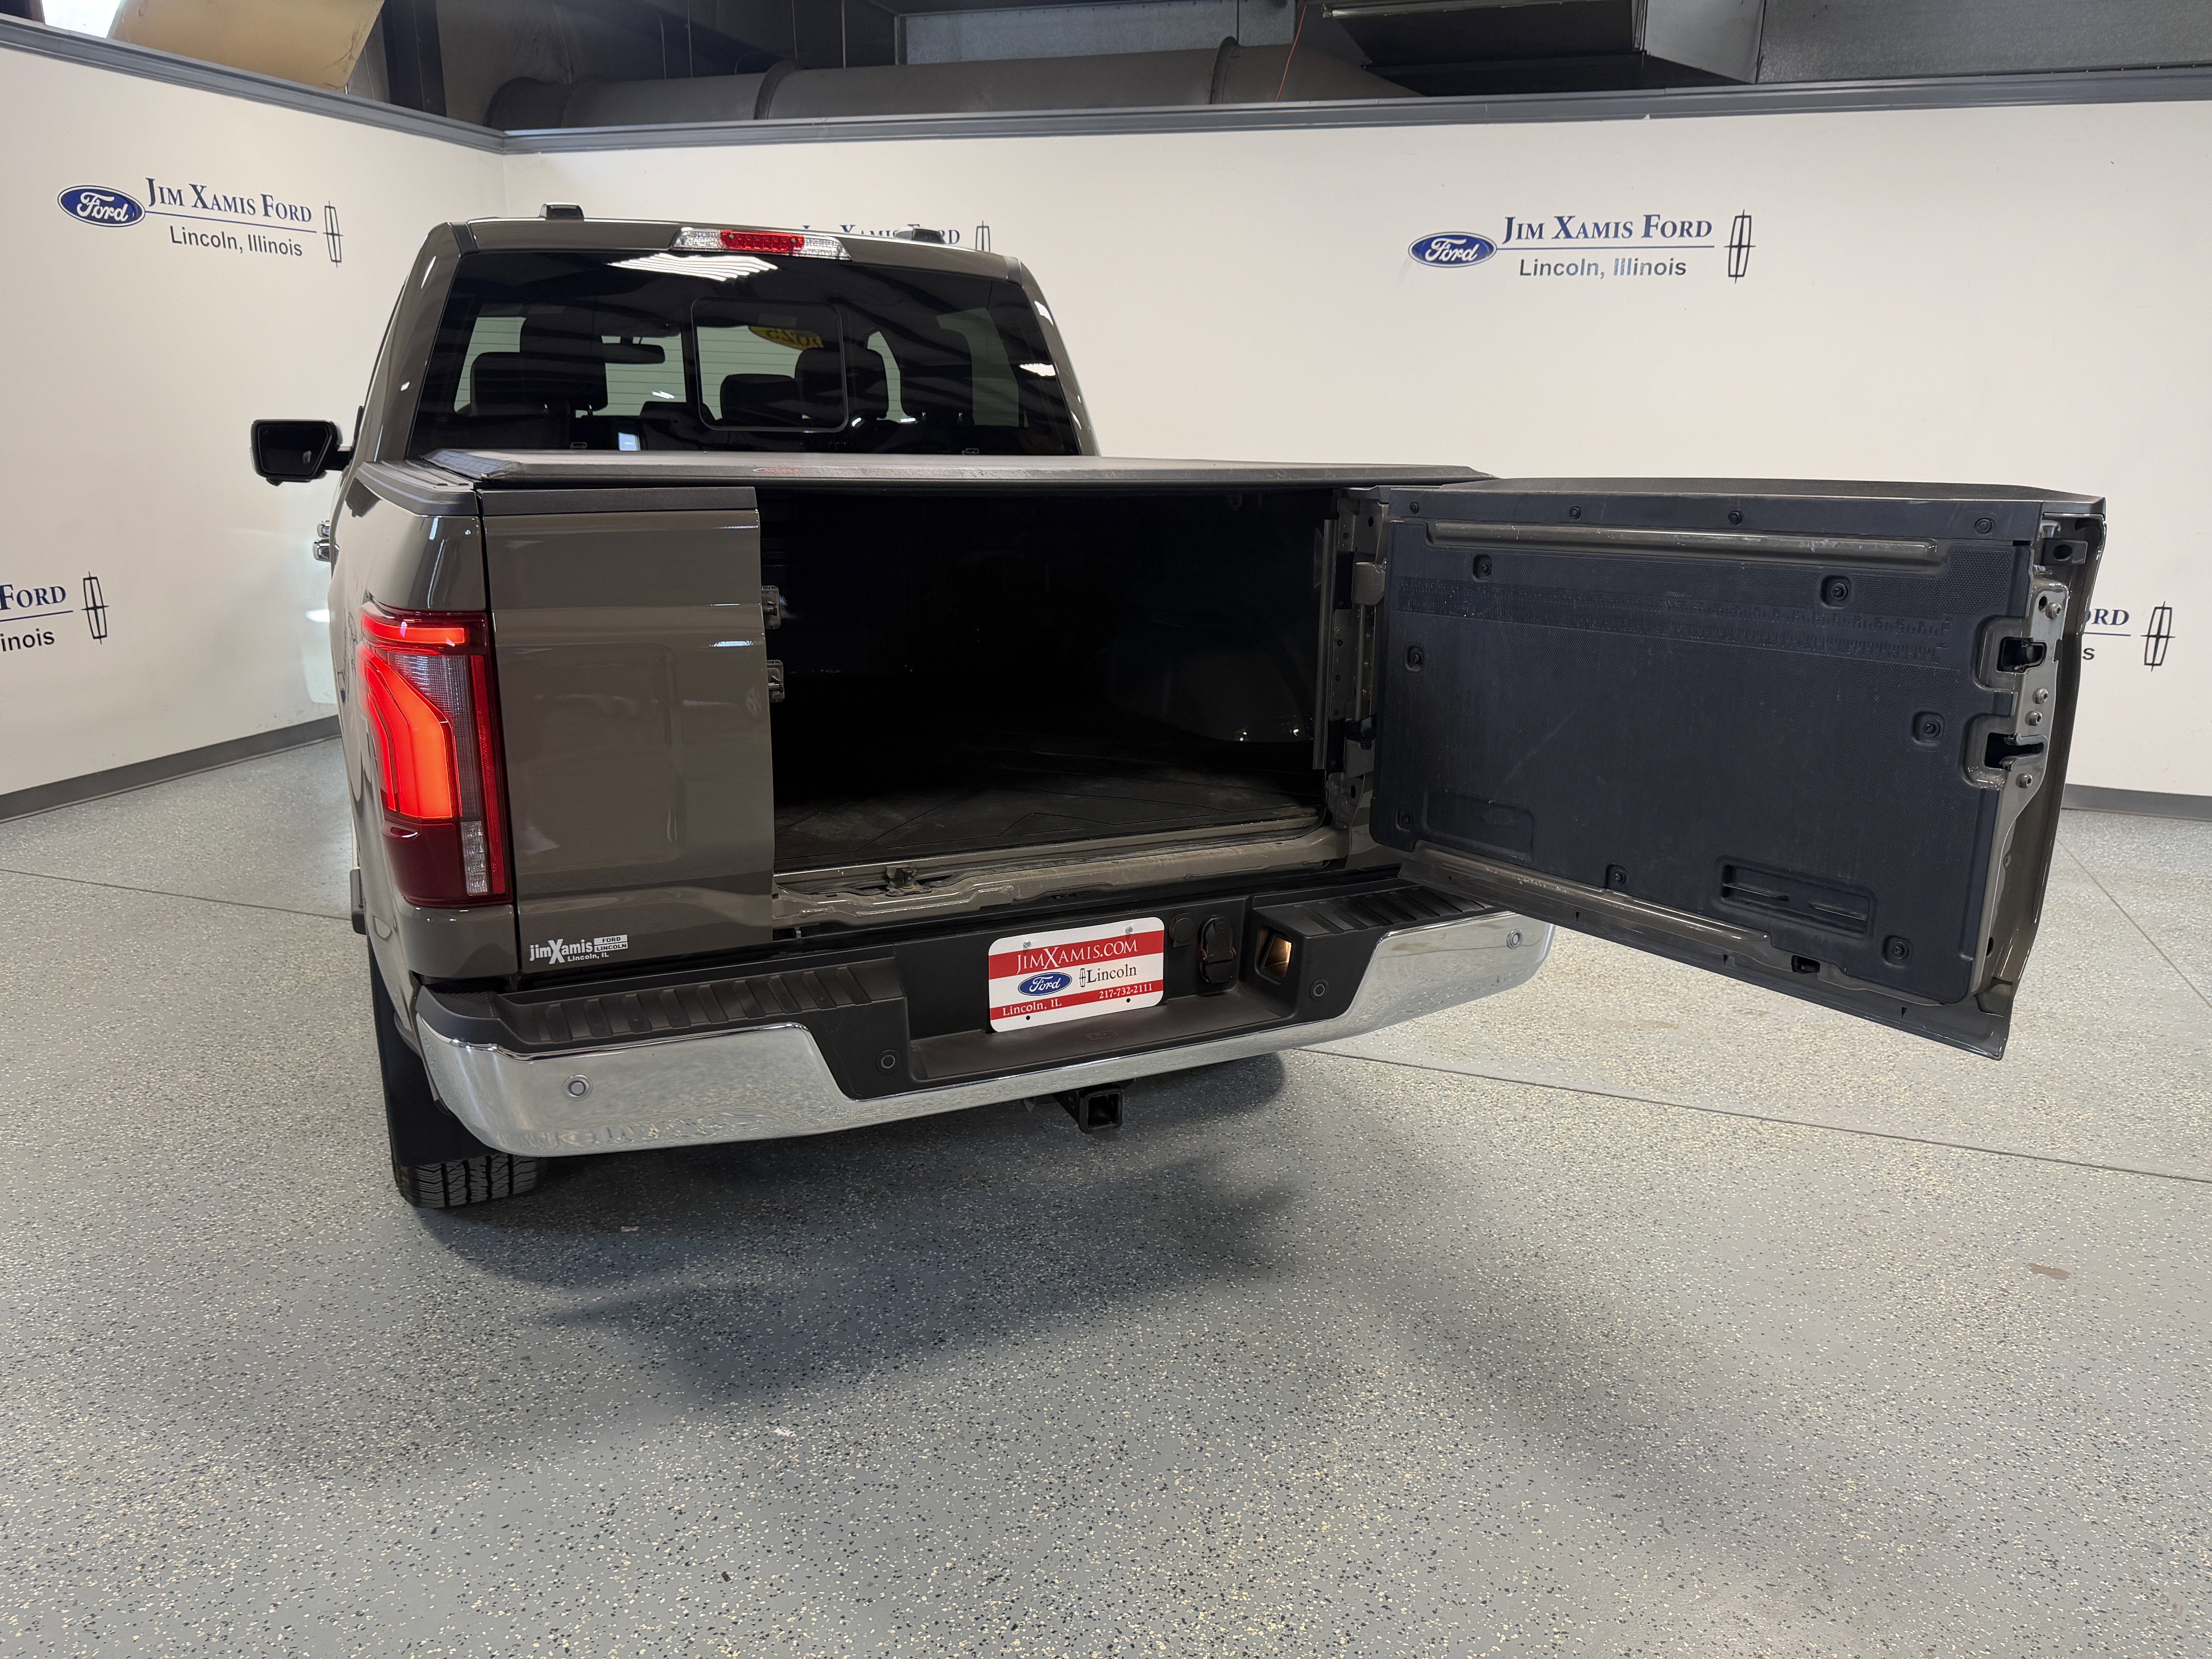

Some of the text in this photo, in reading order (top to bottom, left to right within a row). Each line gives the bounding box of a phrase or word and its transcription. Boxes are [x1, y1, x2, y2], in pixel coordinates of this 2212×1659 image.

[77, 192, 129, 222] Ford
[145, 177, 312, 222] JIM XAMIS FORD
[1502, 214, 1712, 244] JIM XAMIS FORD
[170, 225, 303, 256] Lincoln, Illinois
[1425, 238, 1478, 262] Ford
[1519, 258, 1686, 279] Lincoln, Illinois
[2088, 608, 2129, 625] RD
[530, 939, 593, 964] jimXamis
[568, 953, 599, 962] Lincoln,
[1017, 939, 1138, 975] JIMXAMIS.COM
[1029, 975, 1061, 992] Ford
[1086, 964, 1137, 983] Lincoln
[1099, 983, 1152, 999] 217-732-2111
[1002, 999, 1062, 1016] Lincoln, IL
